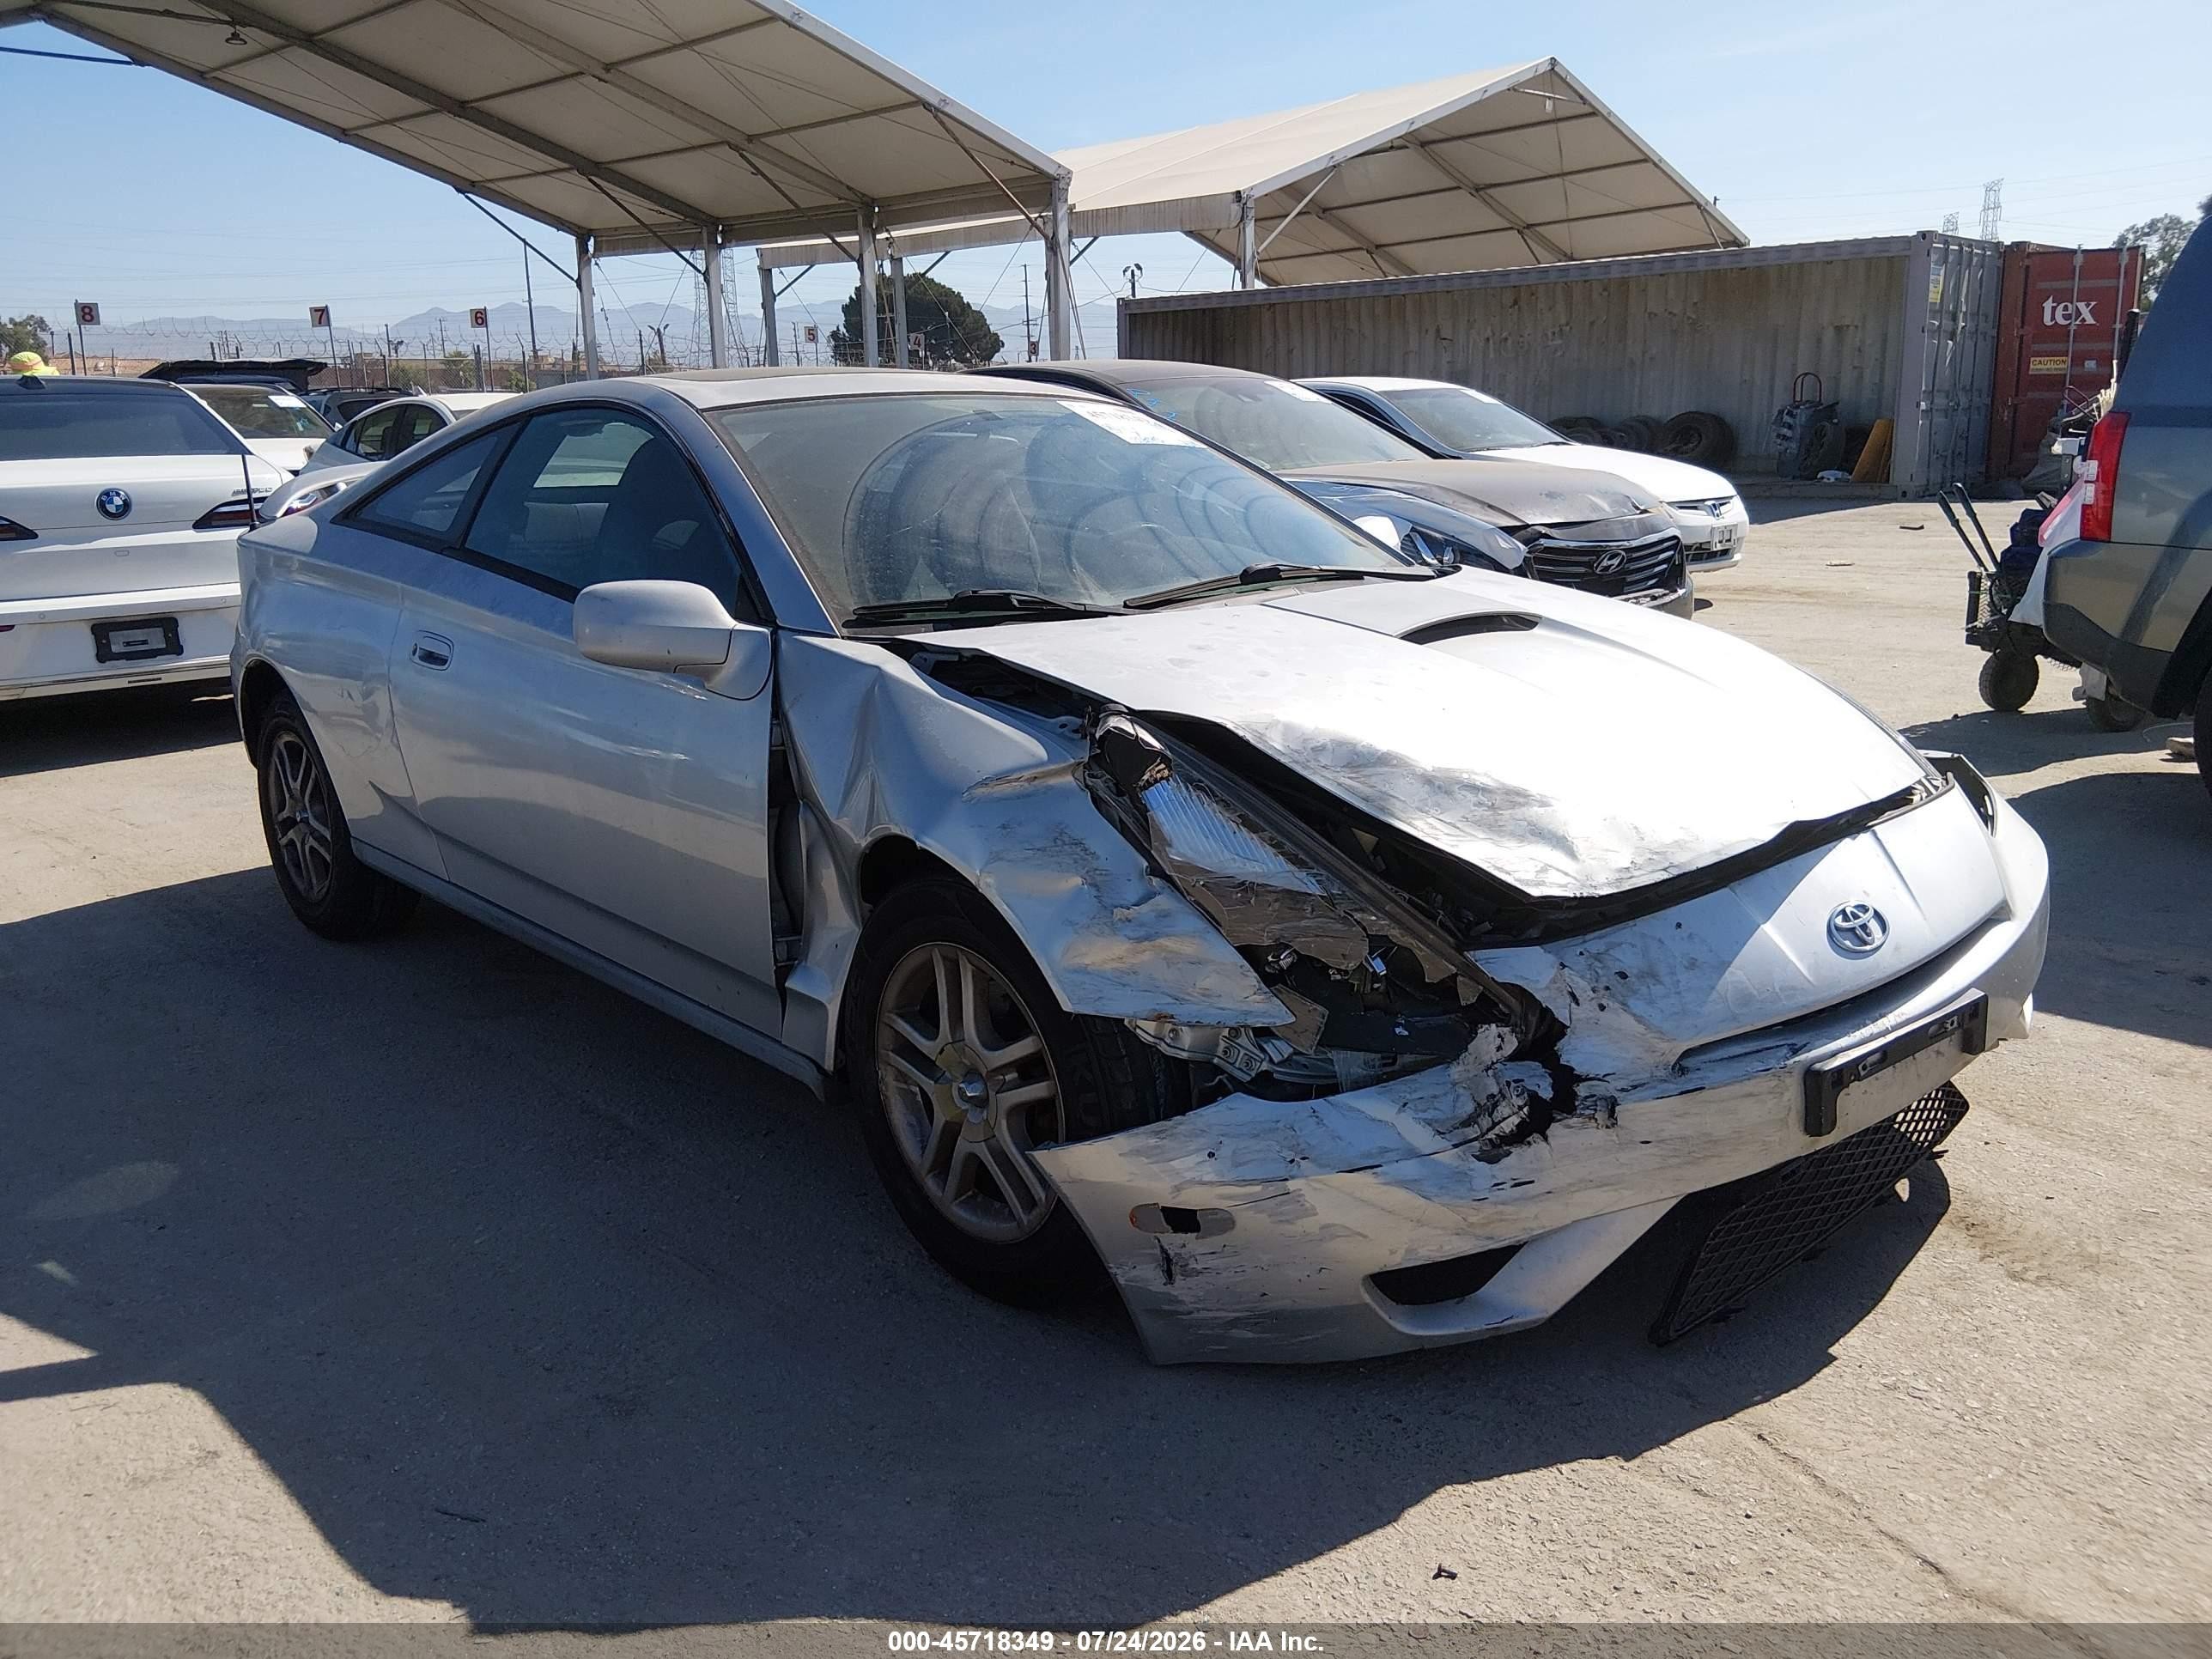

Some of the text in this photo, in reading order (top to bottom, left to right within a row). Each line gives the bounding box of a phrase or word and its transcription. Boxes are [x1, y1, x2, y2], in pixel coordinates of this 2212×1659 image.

[81, 305, 94, 323] 8
[313, 308, 325, 325] 7
[474, 310, 485, 326] 6
[2042, 295, 2098, 326] tex
[807, 328, 816, 342] 5
[913, 336, 921, 348] 4
[1030, 343, 1036, 355] 3
[100, 490, 127, 501] BMW
